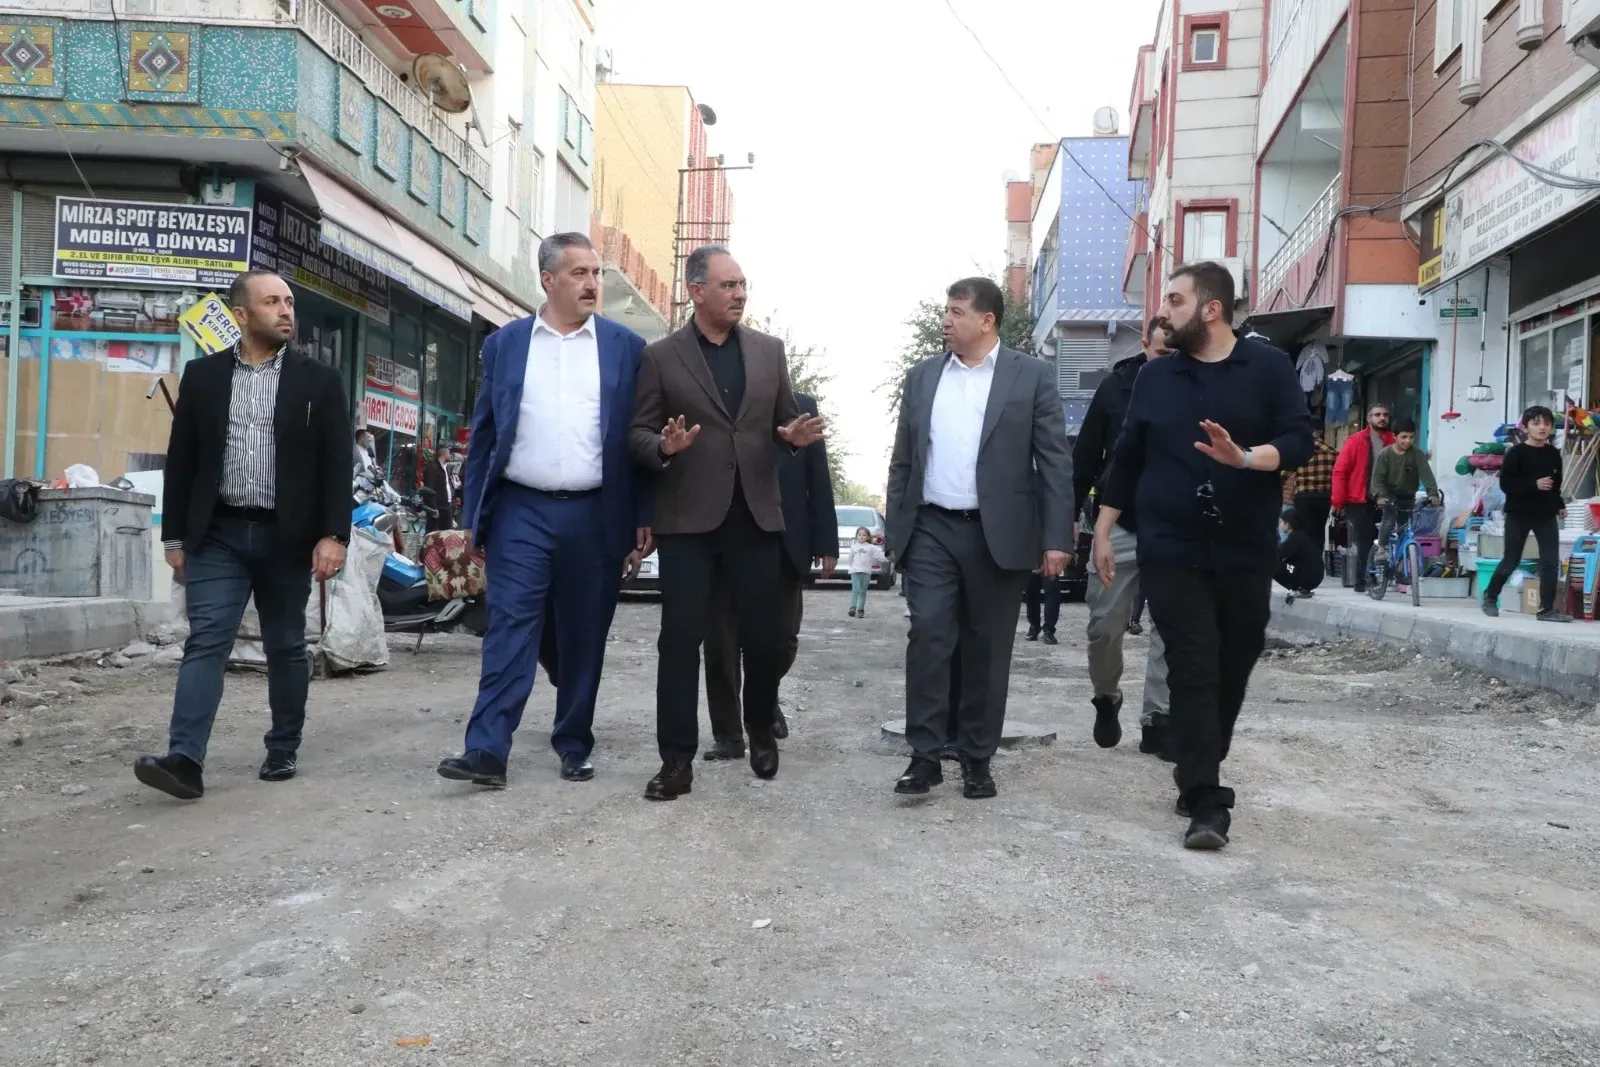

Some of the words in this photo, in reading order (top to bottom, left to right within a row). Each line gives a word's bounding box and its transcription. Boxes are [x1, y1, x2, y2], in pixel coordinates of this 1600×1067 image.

[62, 203, 113, 225] MİRZA
[116, 209, 156, 228] SPOT
[157, 211, 206, 231] BEYAZ
[206, 213, 246, 235] EŞYA
[258, 202, 277, 222] MİRZA
[70, 228, 150, 247] MOBİLYA
[156, 231, 236, 253] DÜNYASI
[259, 220, 275, 238] SPOT
[103, 253, 123, 261] SIFIR
[125, 254, 149, 262] BEYAZ
[151, 256, 171, 265] EŞYA
[301, 251, 331, 280] MOBİLYA
[206, 302, 242, 340] MERCE
[395, 404, 417, 431] GROSS
